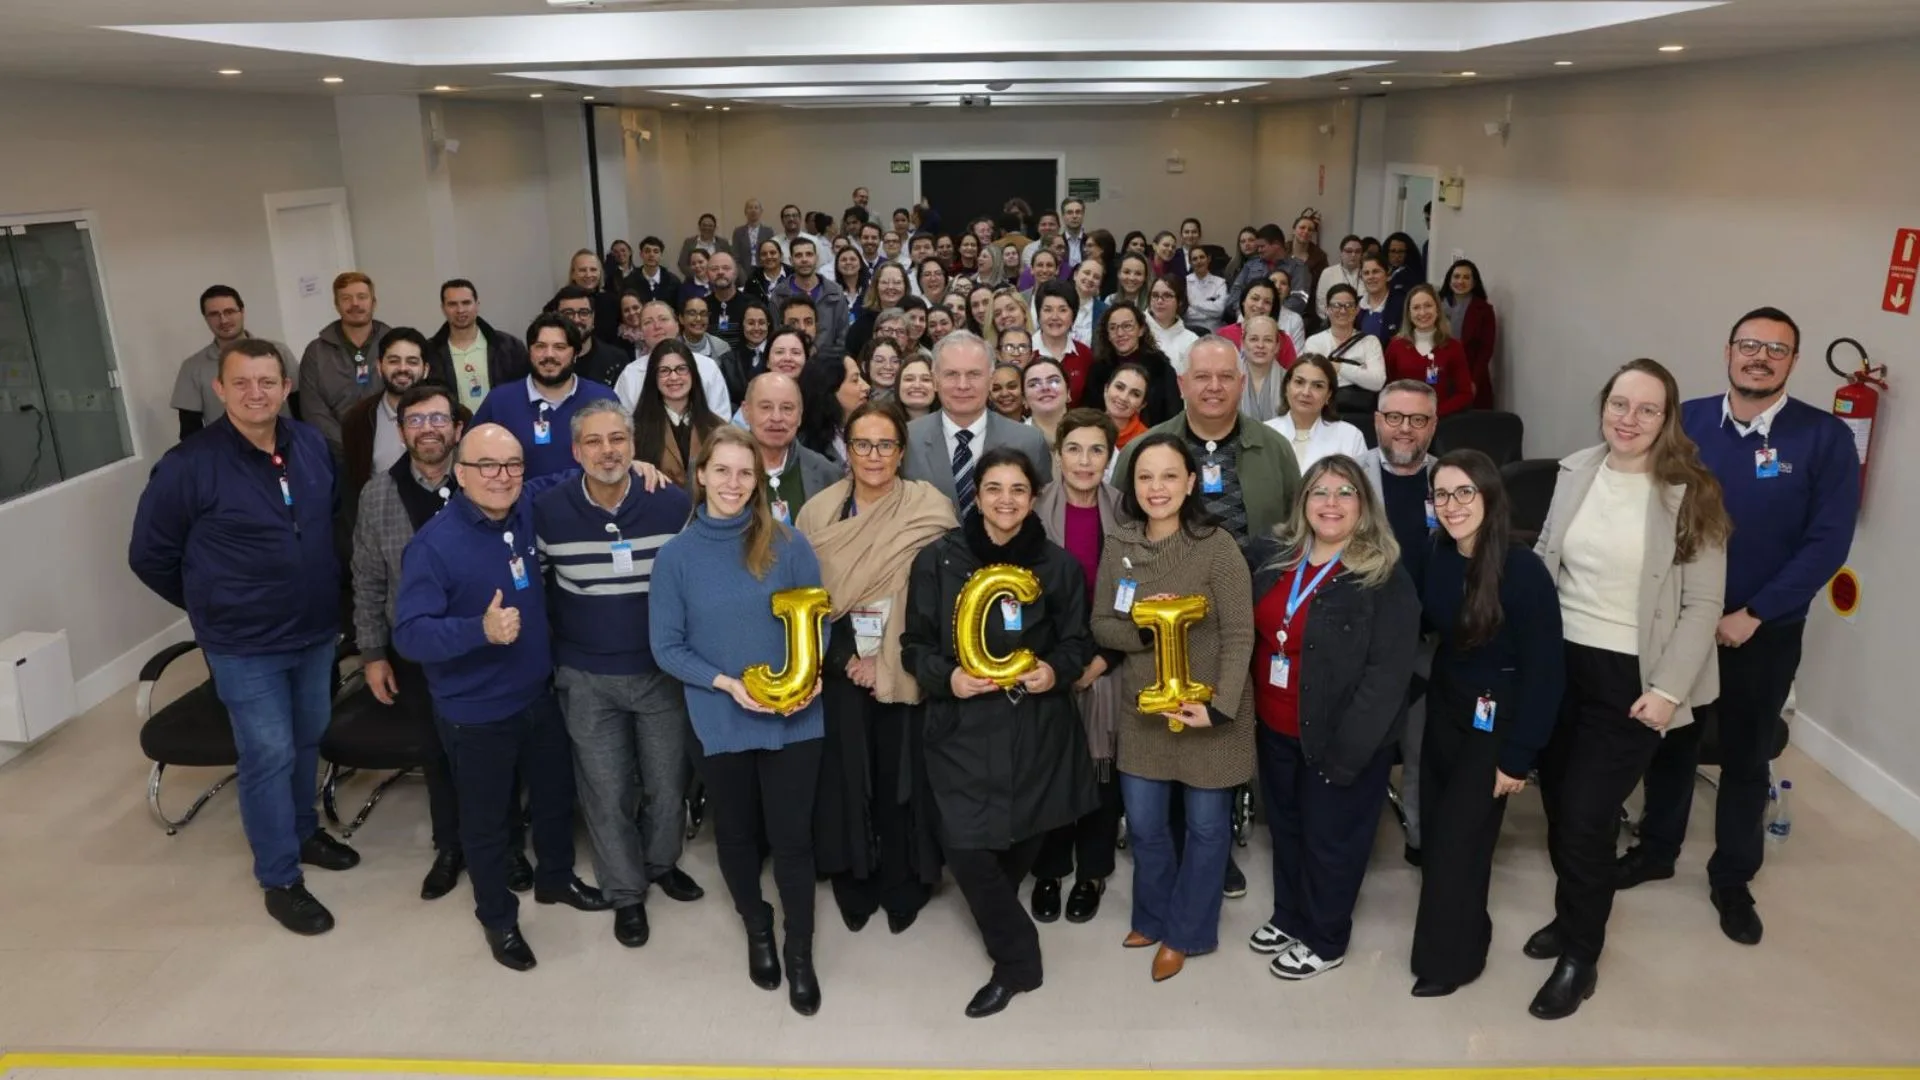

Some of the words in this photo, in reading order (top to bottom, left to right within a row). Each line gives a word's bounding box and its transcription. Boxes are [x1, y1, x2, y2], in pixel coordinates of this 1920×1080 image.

[743, 588, 831, 709] J
[952, 564, 1042, 687] C
[1131, 593, 1214, 714] I
